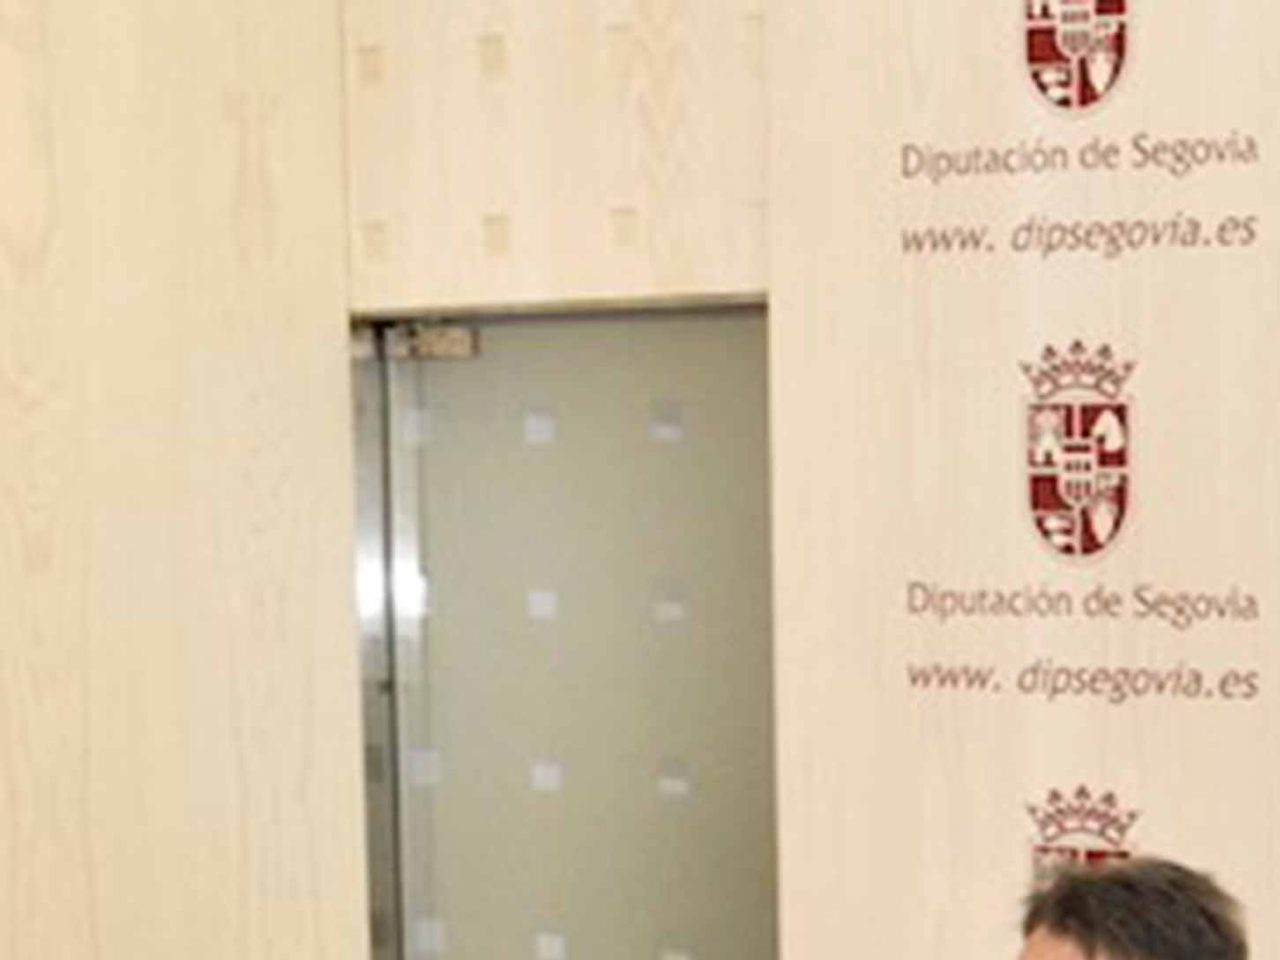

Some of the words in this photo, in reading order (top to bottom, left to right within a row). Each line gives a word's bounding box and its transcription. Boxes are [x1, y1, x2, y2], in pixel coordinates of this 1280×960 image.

[901, 138, 1068, 184] Diputación
[1079, 137, 1119, 170] de
[1131, 130, 1259, 178] Segovia
[902, 225, 995, 253] www.
[1010, 211, 1258, 259] dipsegovia.es
[906, 580, 1072, 622] Diputación
[1083, 586, 1123, 619] de
[1133, 584, 1260, 630] Segovia
[907, 663, 1001, 692] www.
[1016, 659, 1260, 703] dipsegovia.es
